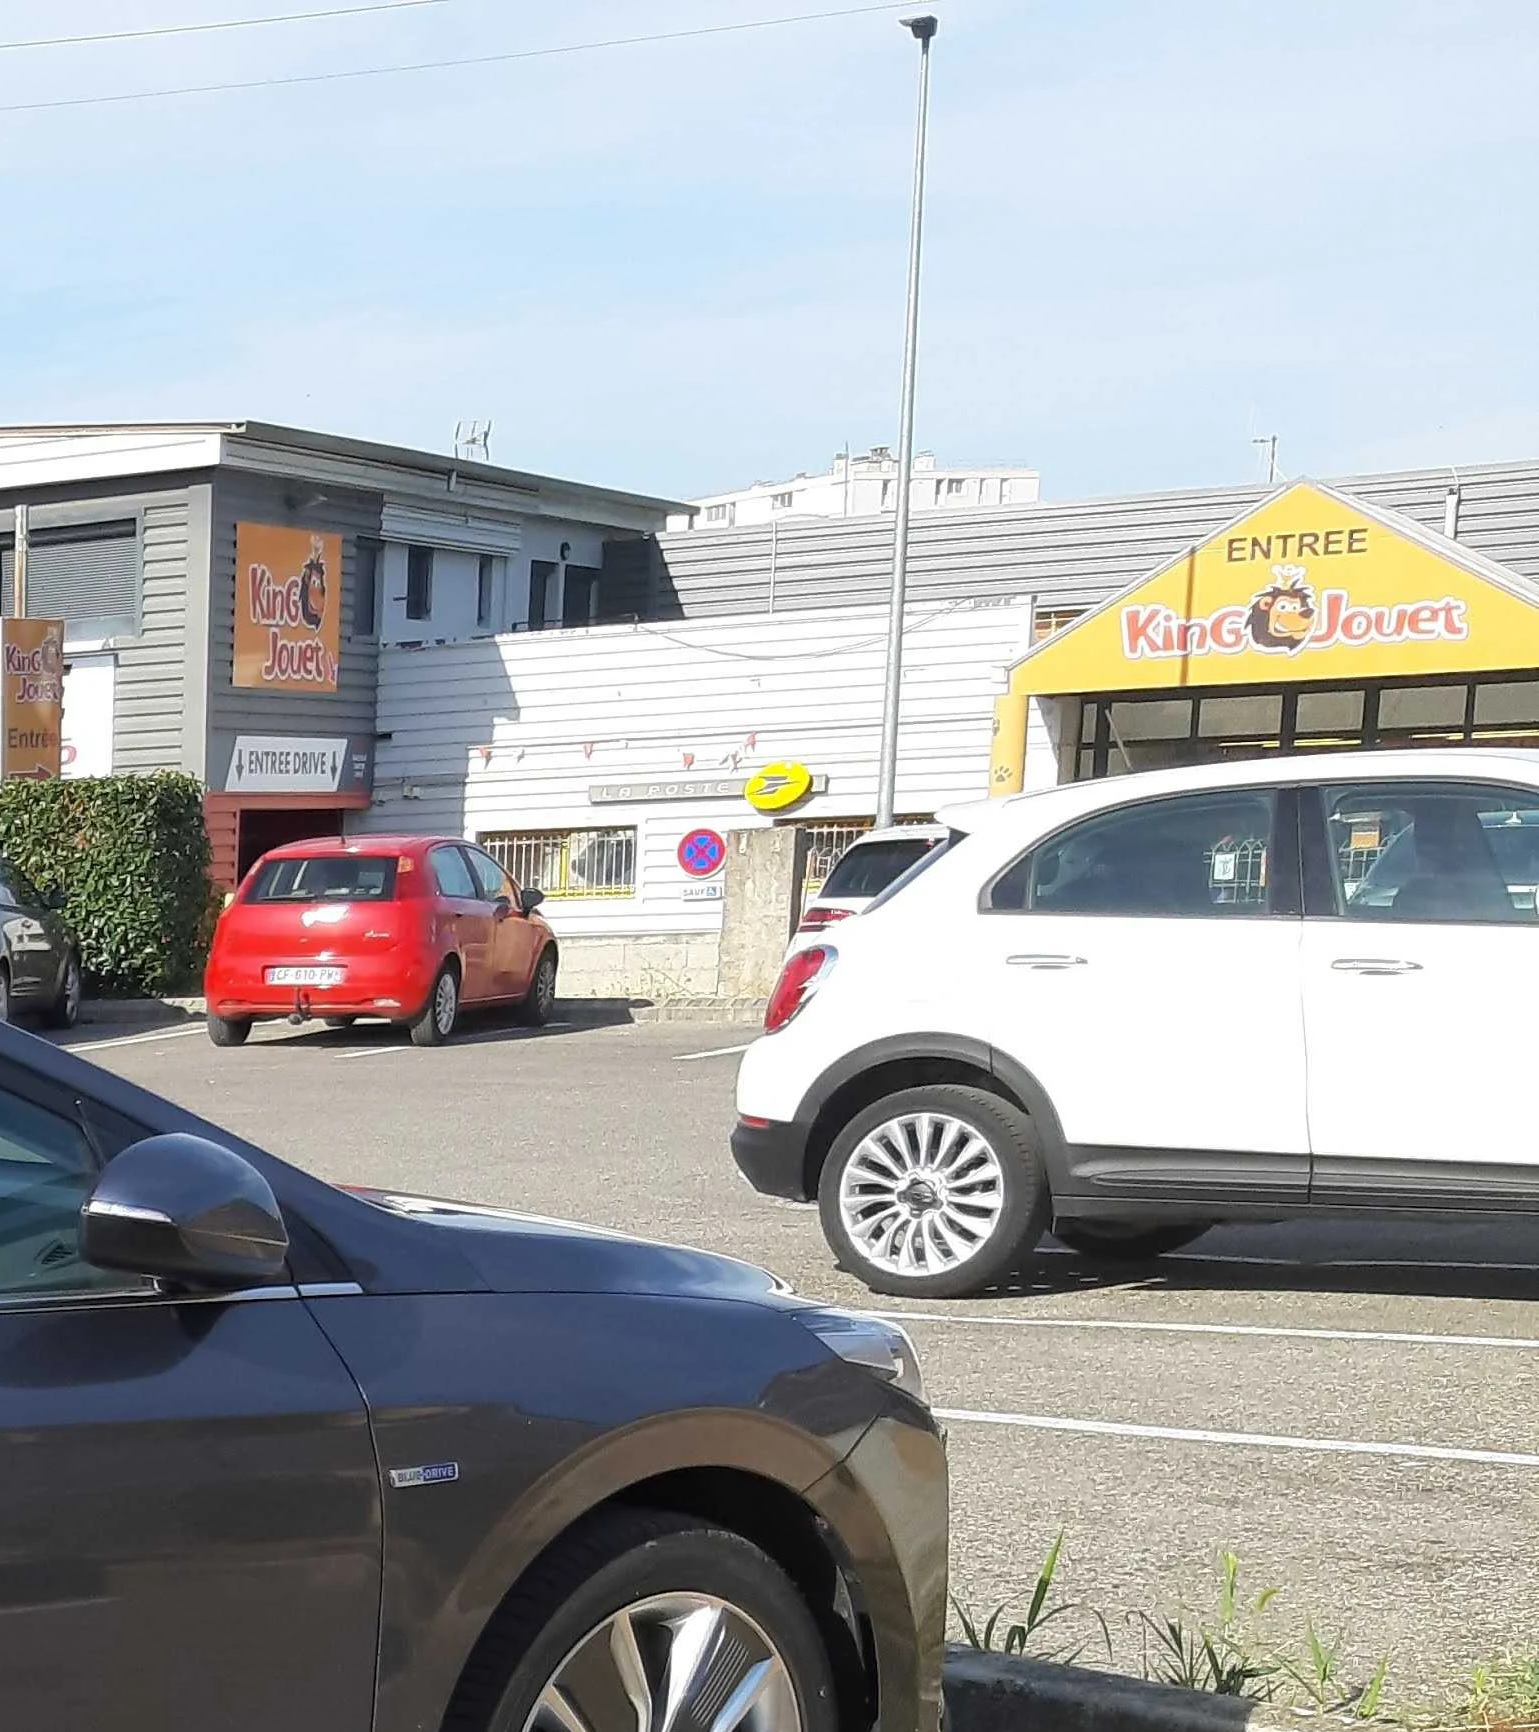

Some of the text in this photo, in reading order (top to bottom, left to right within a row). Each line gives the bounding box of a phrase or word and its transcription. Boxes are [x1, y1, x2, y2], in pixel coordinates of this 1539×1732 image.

[1227, 527, 1368, 562] ENTREE
[1310, 592, 1465, 643] Jouet
[263, 630, 323, 681] Jouet
[16, 676, 58, 702] Jouet
[248, 751, 291, 775] ENTREE
[293, 752, 327, 776] DRIVE
[602, 783, 730, 799] LA POSTE
